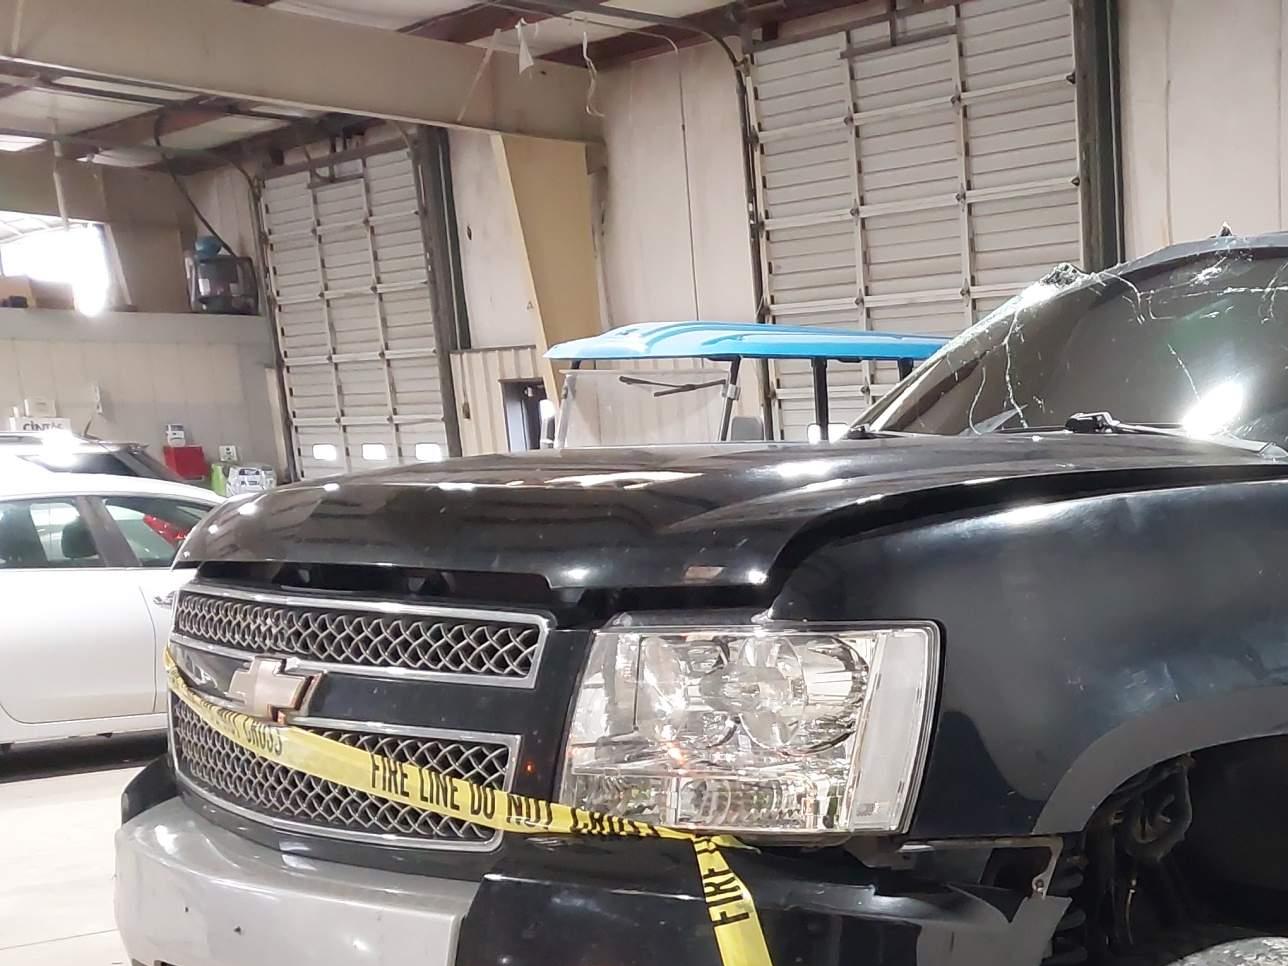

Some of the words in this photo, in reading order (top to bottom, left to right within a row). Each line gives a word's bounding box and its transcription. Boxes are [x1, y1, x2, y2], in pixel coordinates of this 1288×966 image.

[370, 752, 410, 798] FIRE
[418, 766, 460, 811] LINE
[702, 868, 750, 927] FIRE
